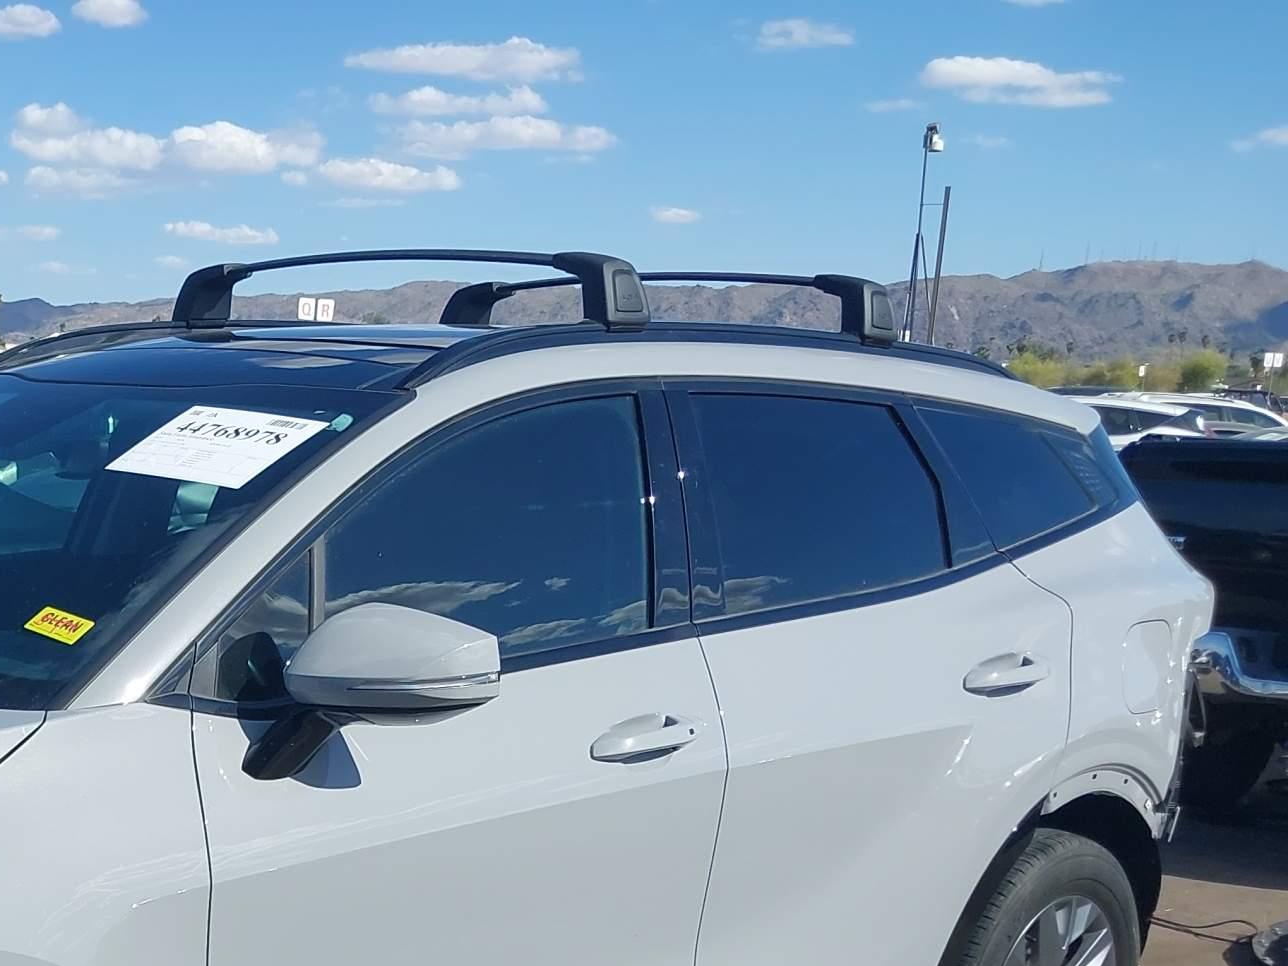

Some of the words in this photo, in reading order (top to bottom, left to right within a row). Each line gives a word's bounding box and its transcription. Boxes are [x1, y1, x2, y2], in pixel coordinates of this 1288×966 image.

[302, 302, 312, 316] Q
[321, 303, 330, 318] R
[175, 420, 289, 446] 44768978
[40, 612, 85, 634] CLEAN
